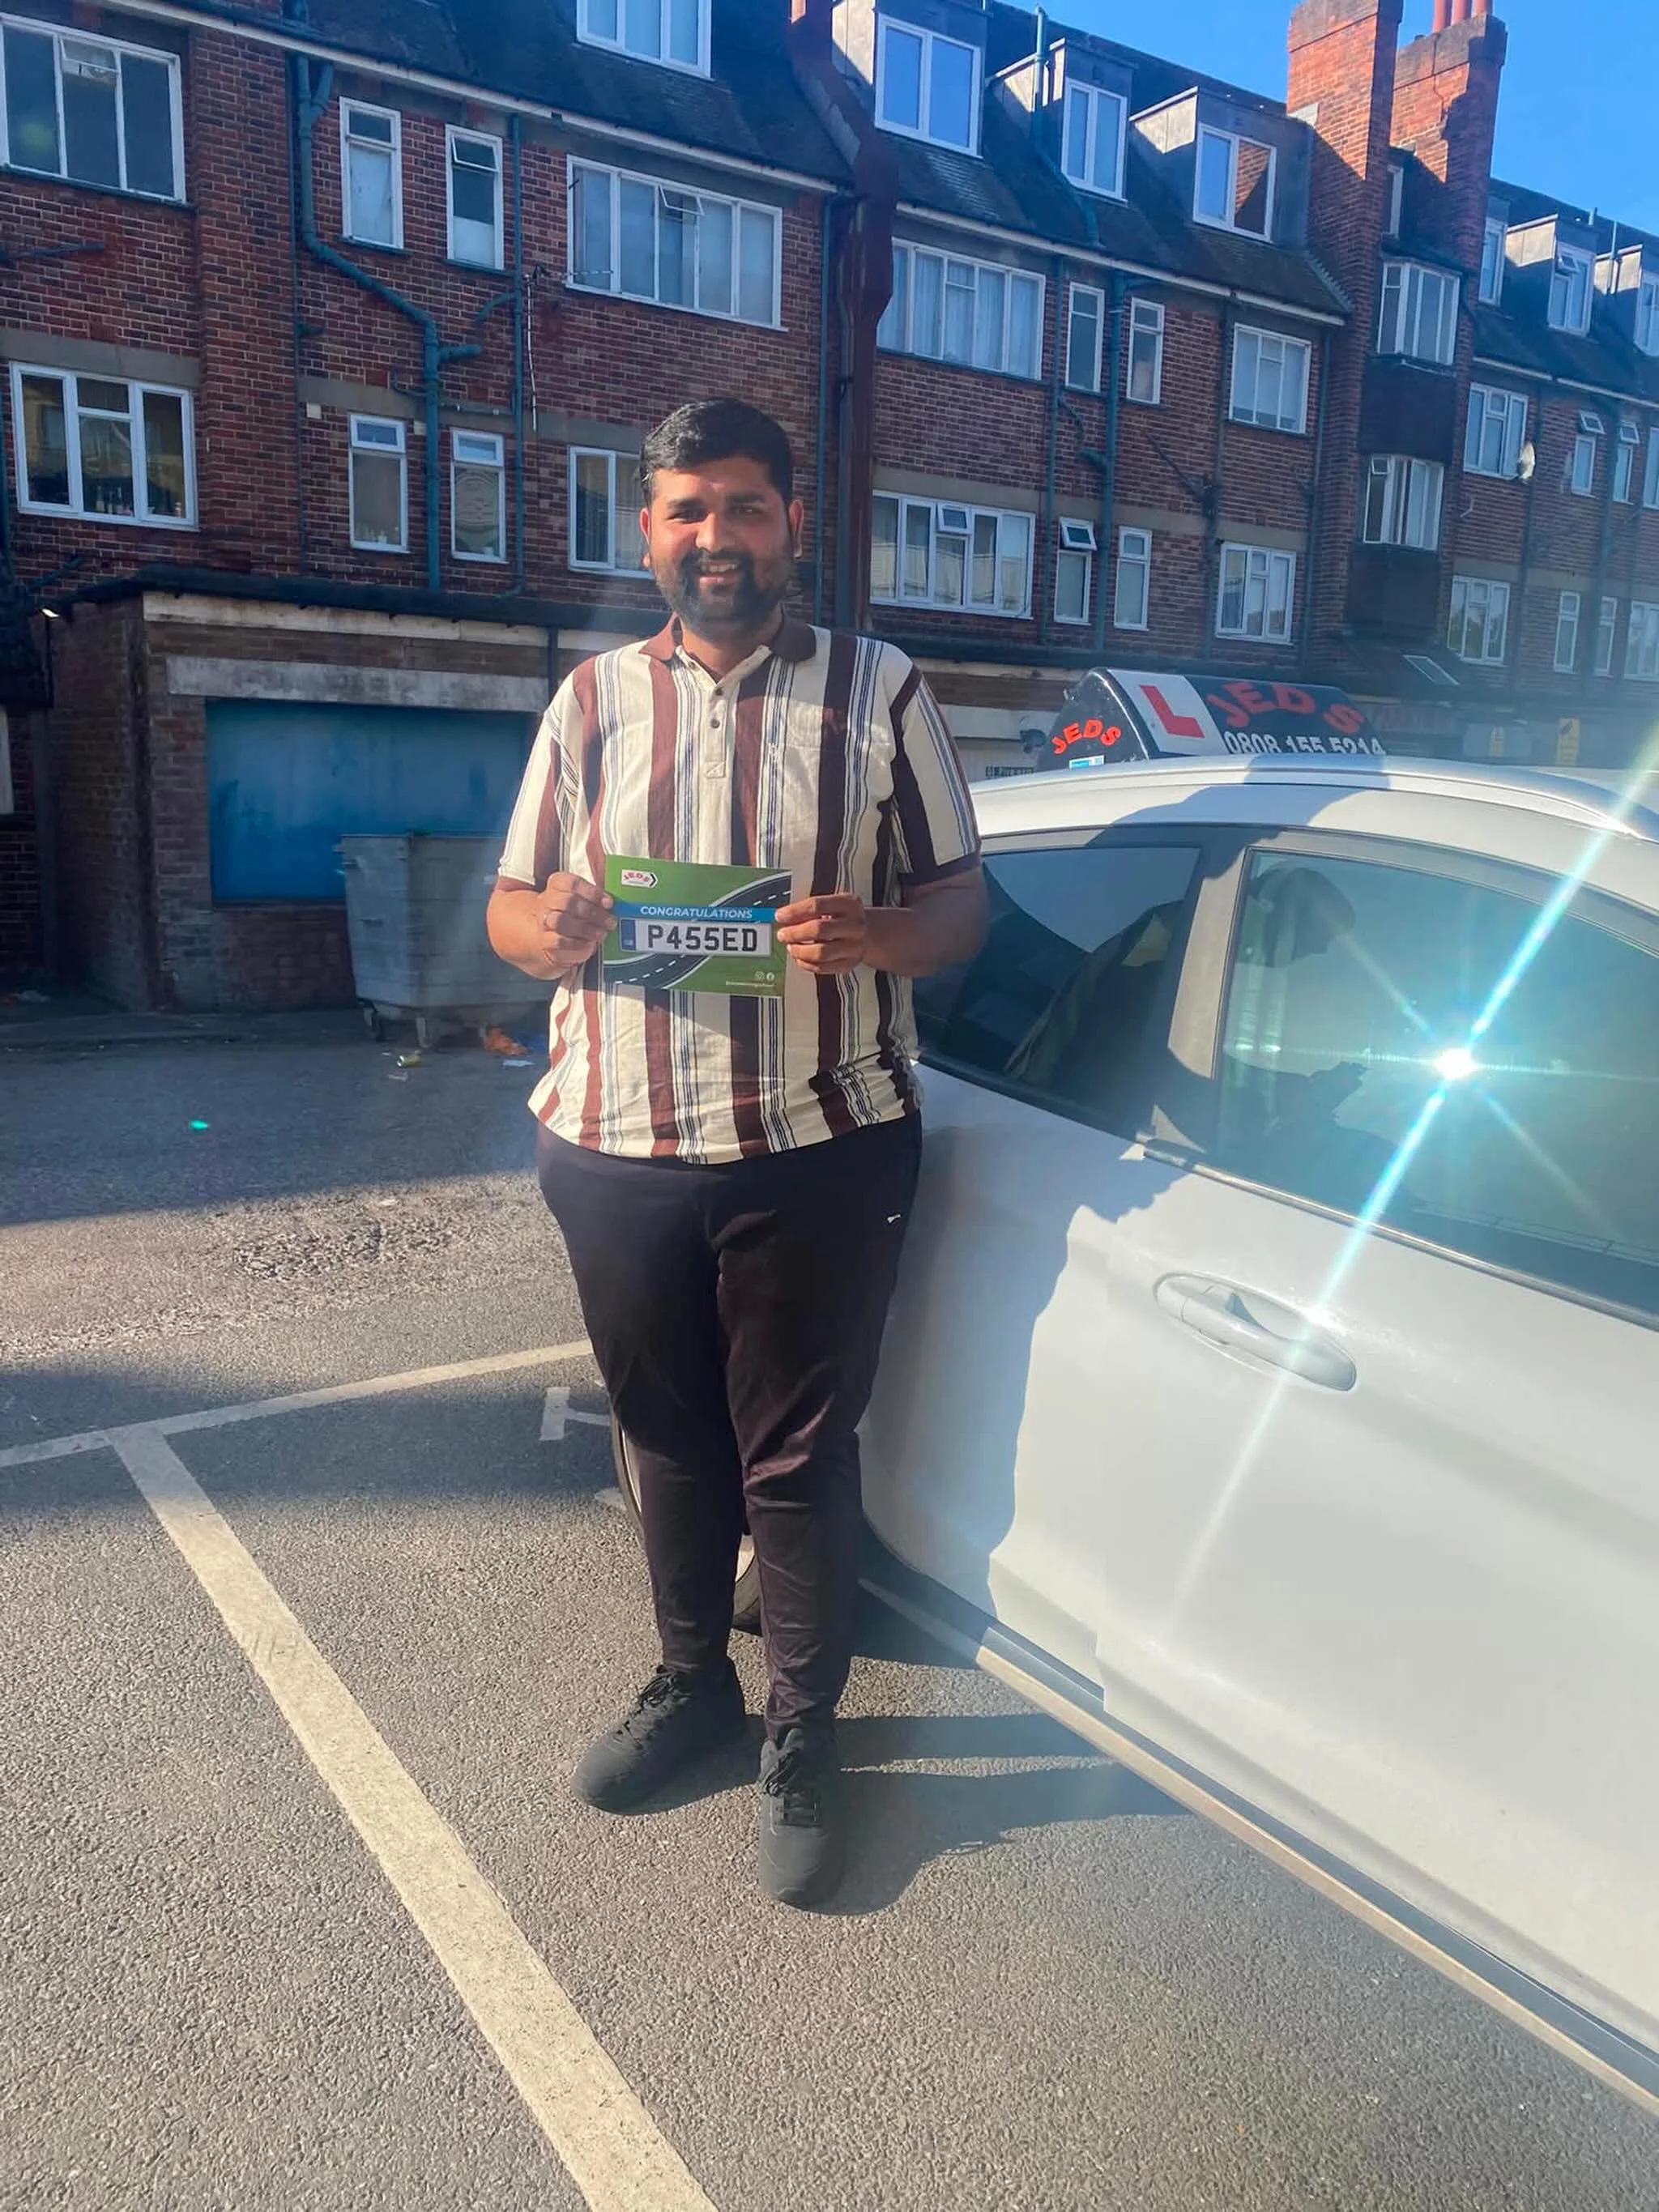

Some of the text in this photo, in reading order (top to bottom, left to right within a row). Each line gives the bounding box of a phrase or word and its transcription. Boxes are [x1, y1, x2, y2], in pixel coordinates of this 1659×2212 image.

[1139, 684, 1205, 739] L
[1207, 681, 1366, 734] JEDS
[1051, 718, 1121, 755] JEDS
[640, 906, 753, 919] CONGRATULATIONS
[647, 924, 758, 953] P455ED
